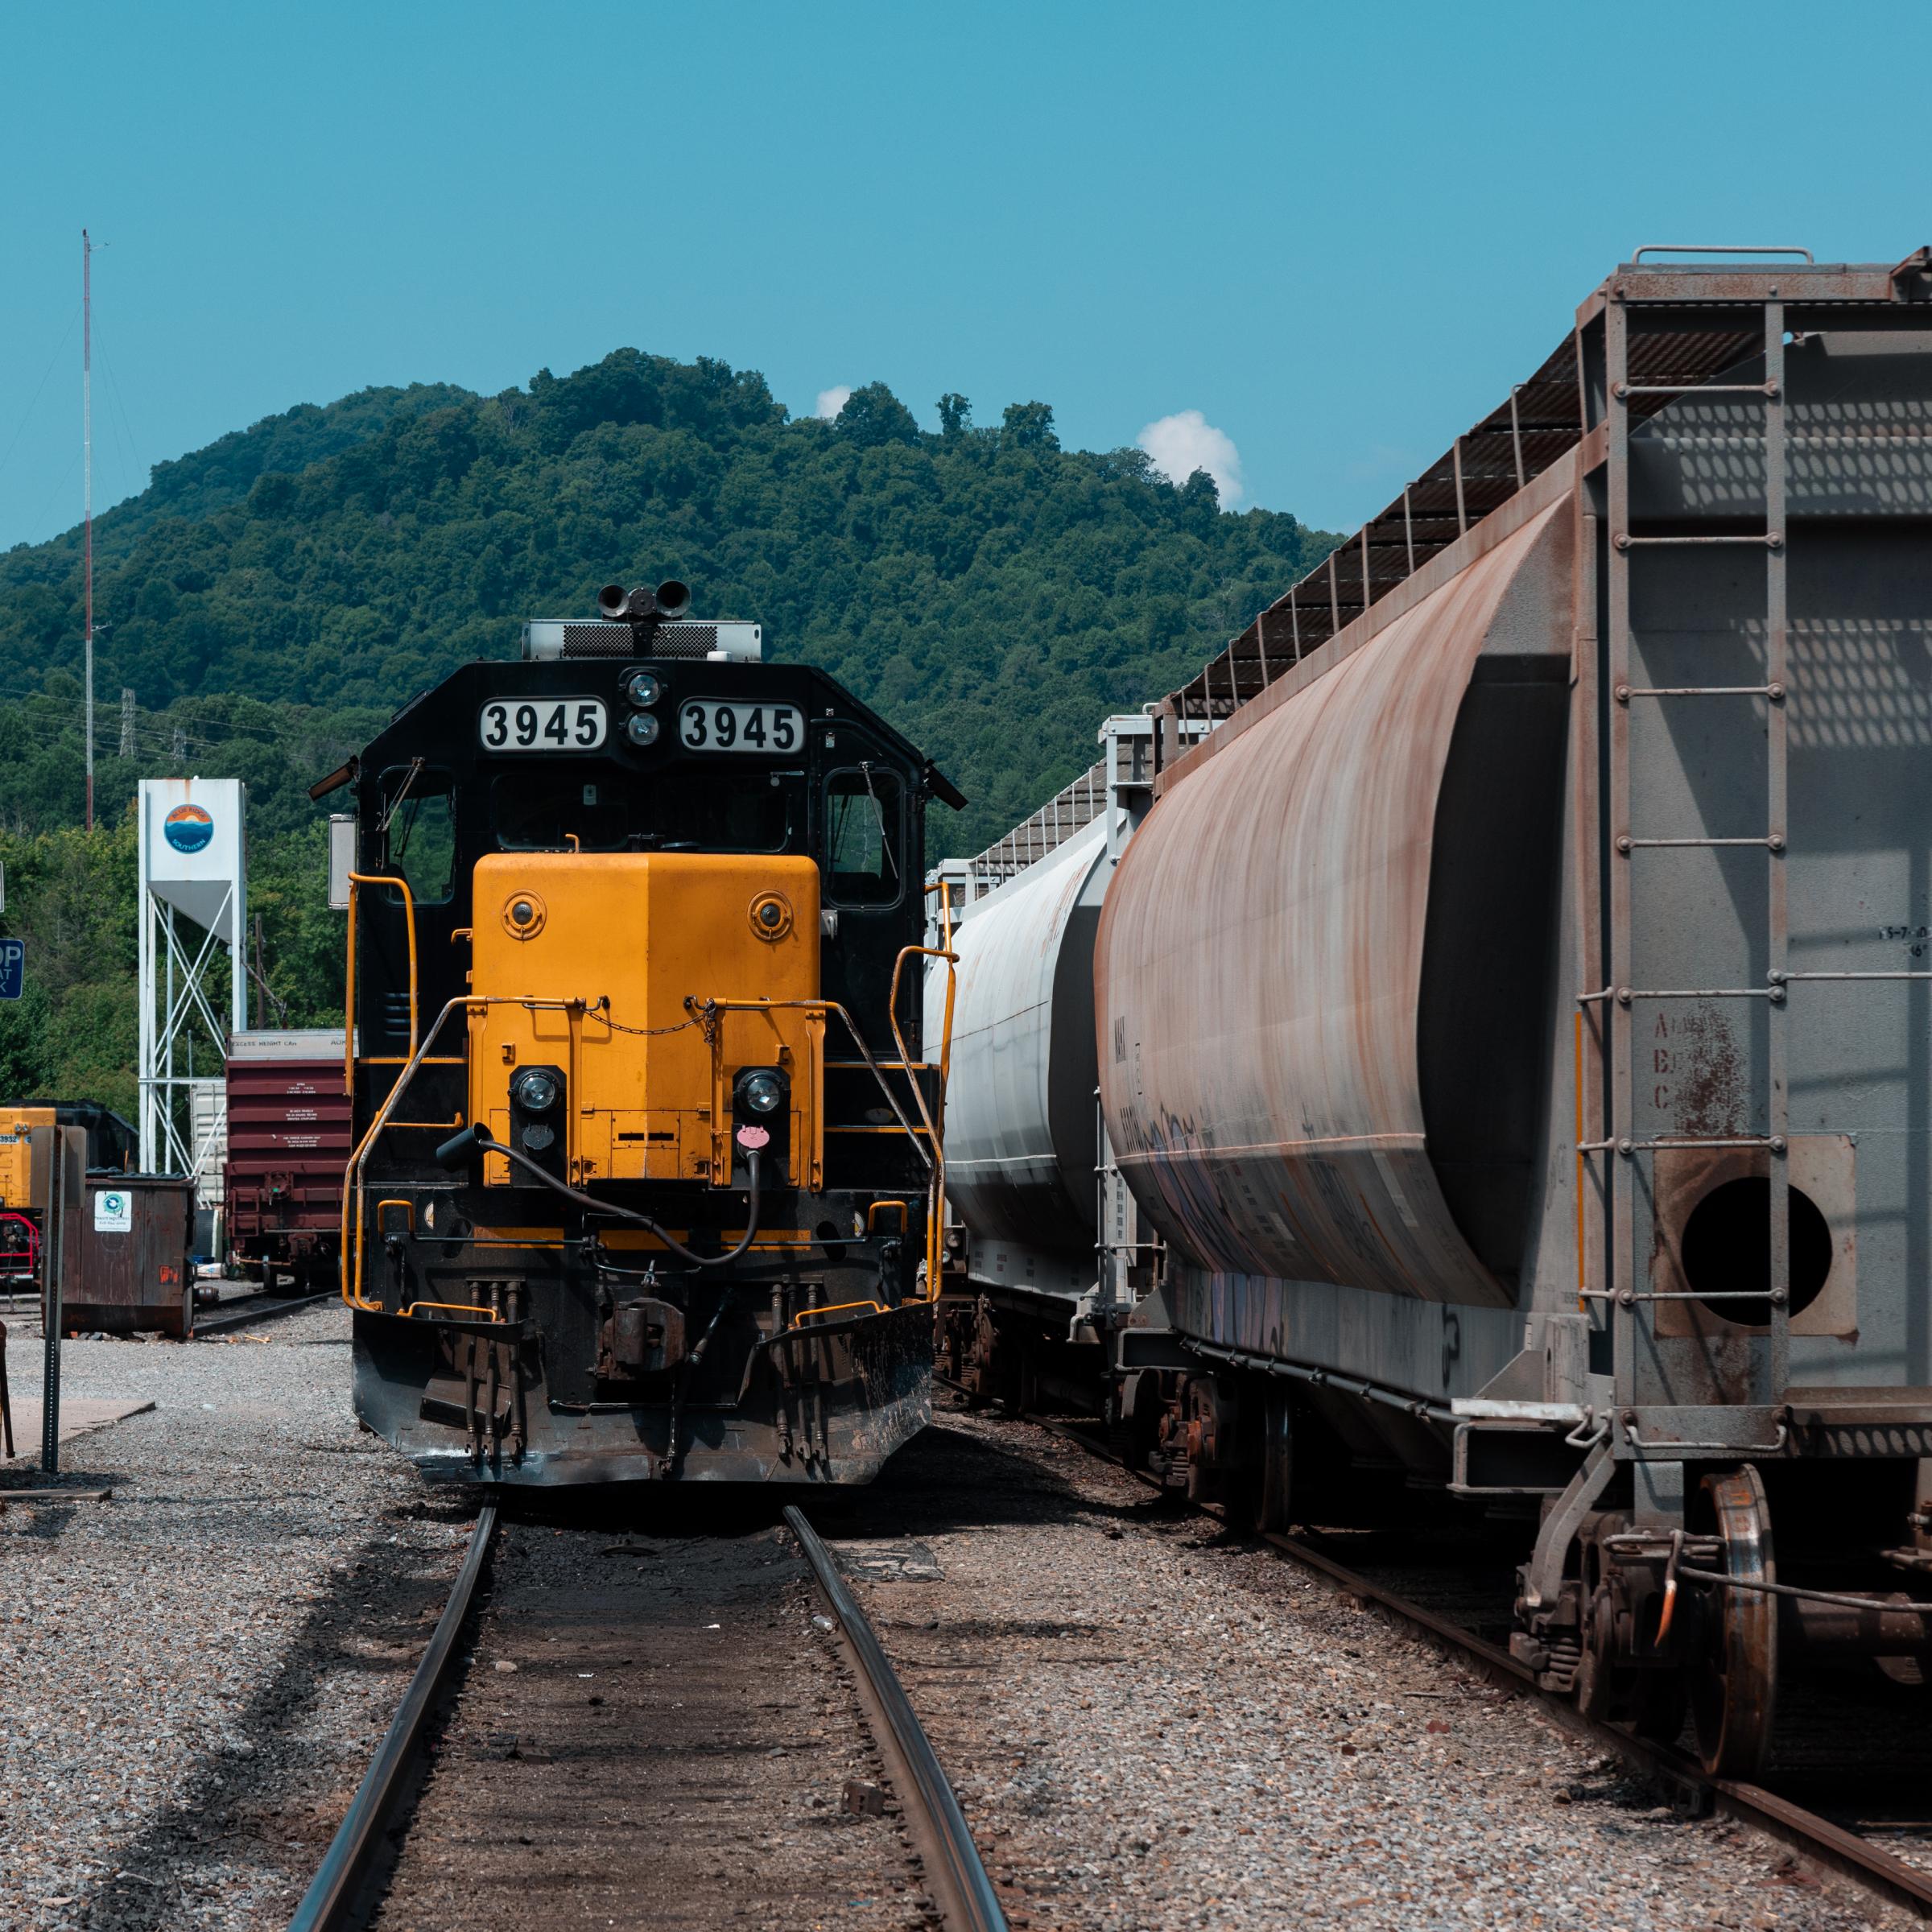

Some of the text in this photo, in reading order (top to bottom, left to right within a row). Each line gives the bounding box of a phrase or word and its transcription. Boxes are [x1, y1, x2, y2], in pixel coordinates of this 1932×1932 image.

[485, 704, 599, 747] 3945
[684, 705, 796, 750] 3945
[171, 838, 206, 851] SOUTHERN
[0, 946, 22, 968] P
[1654, 1013, 1668, 1038] A
[1653, 1049, 1668, 1074] B
[1654, 1085, 1668, 1109] C
